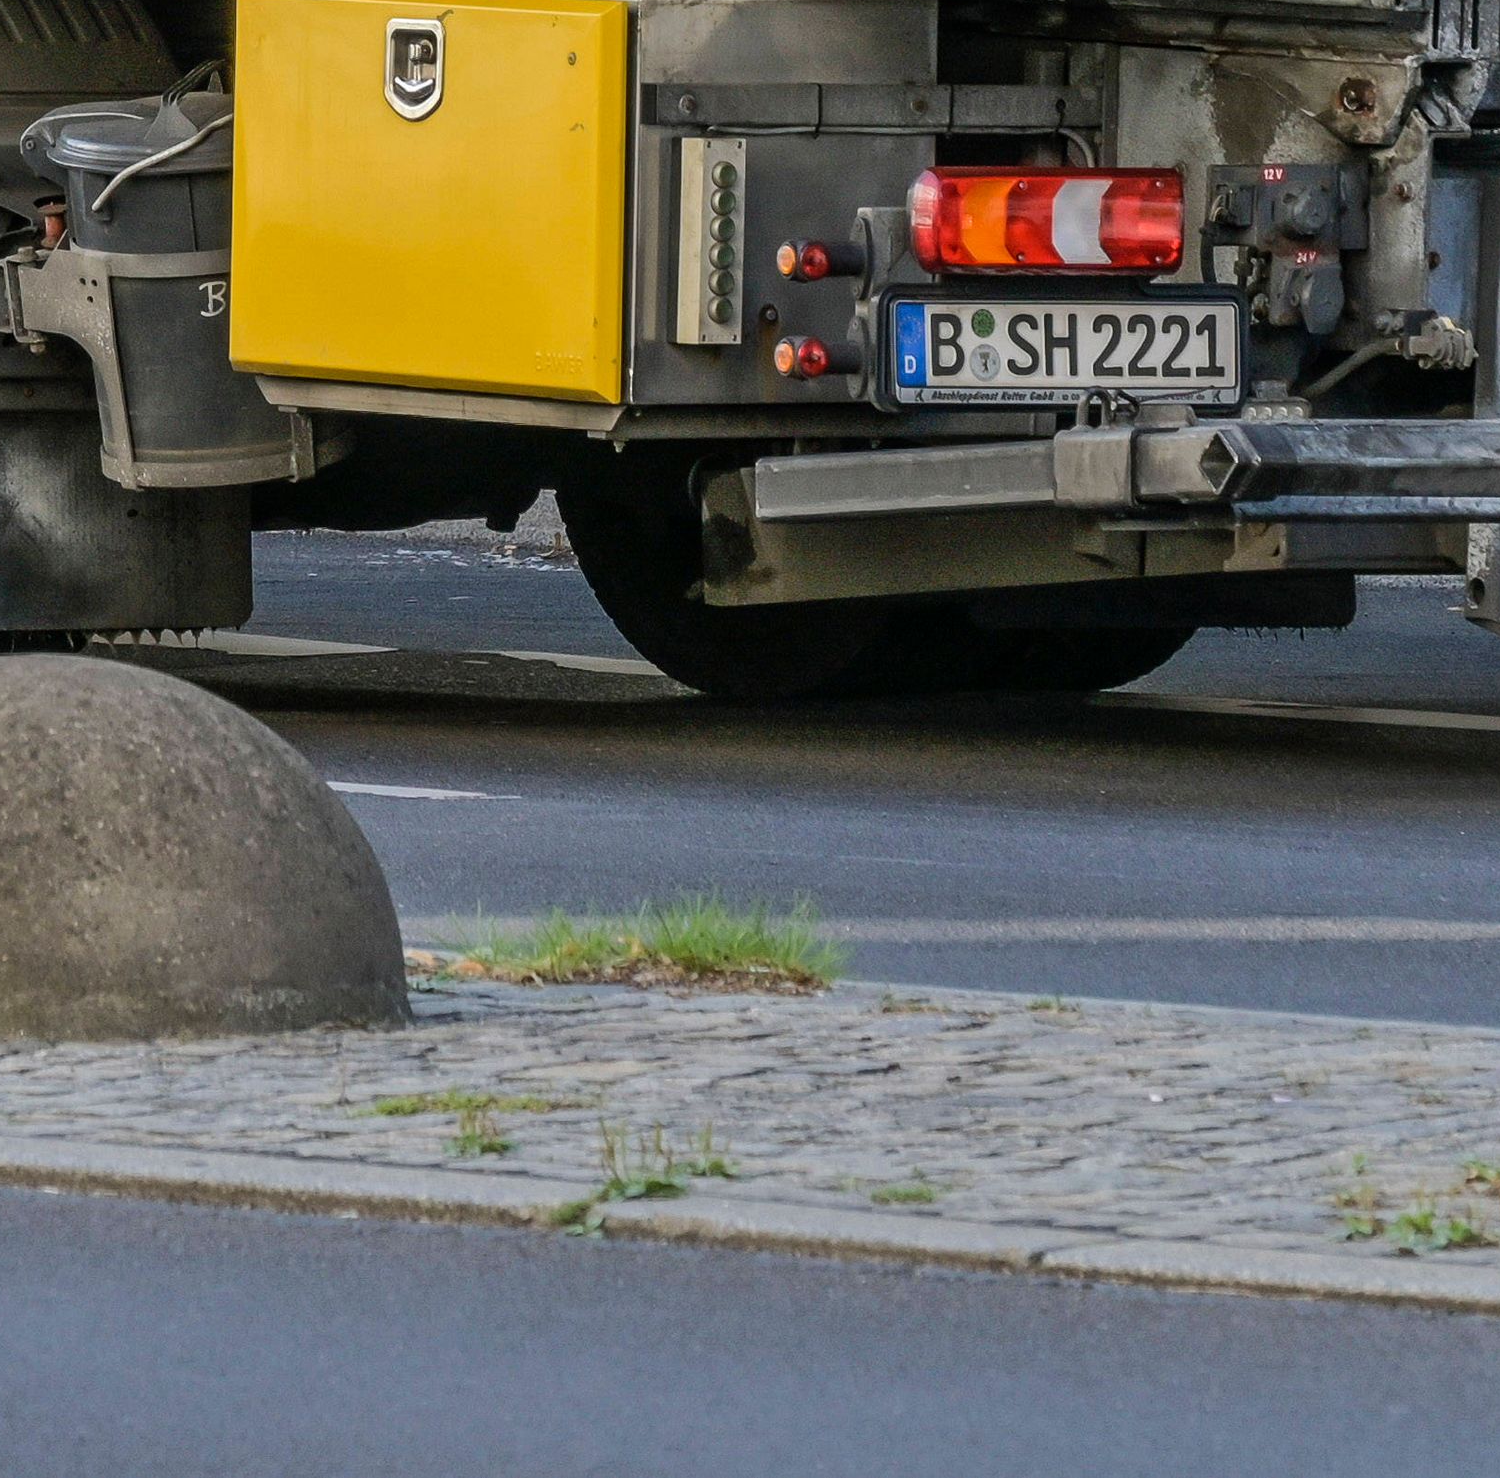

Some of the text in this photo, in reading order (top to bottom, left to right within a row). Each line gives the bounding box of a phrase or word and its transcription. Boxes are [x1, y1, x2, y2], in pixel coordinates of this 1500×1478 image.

[1264, 169, 1283, 180] 12 V
[930, 313, 1225, 377] B SH 2221
[904, 355, 916, 374] D
